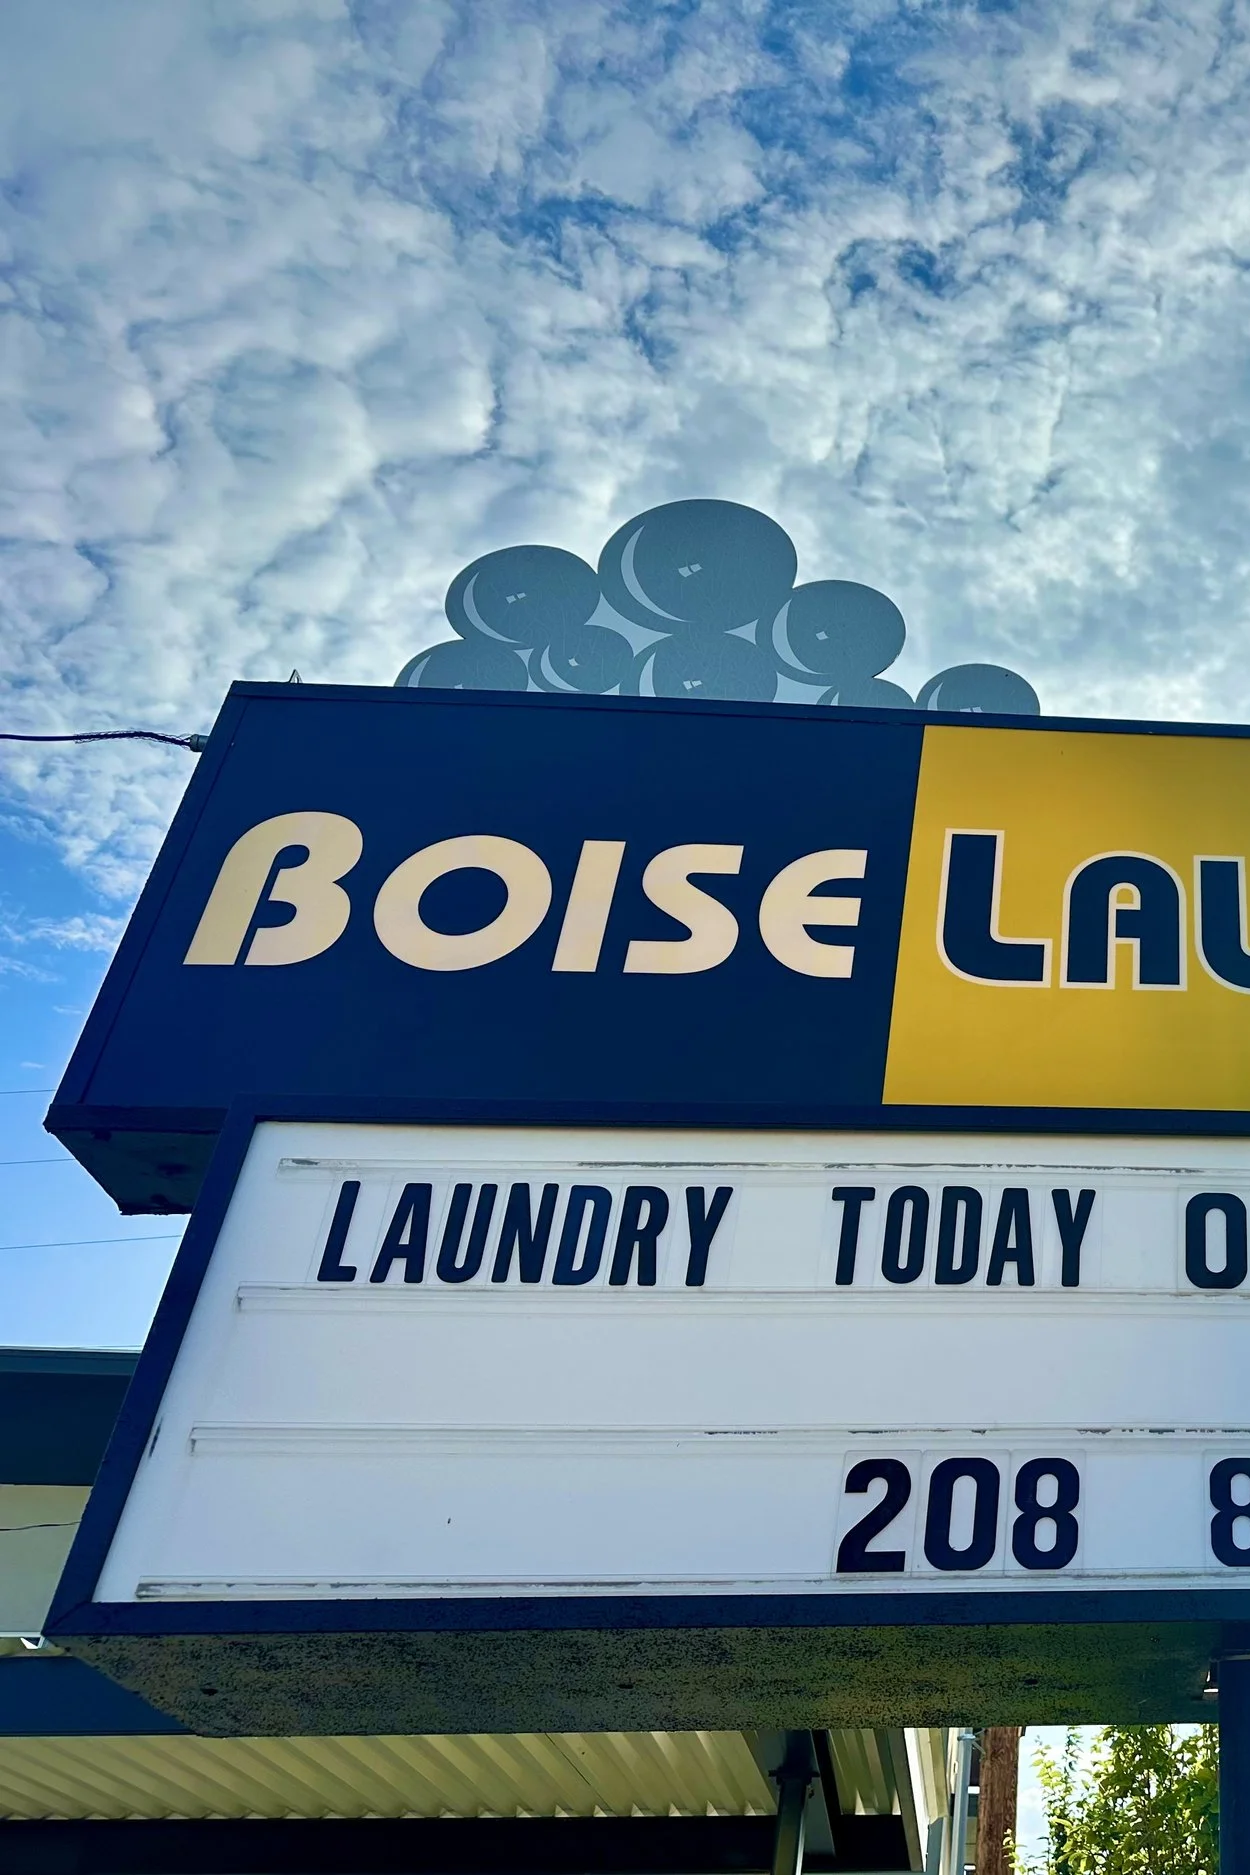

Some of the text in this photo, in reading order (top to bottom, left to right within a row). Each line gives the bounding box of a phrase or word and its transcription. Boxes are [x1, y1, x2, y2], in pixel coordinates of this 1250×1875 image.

[183, 810, 868, 979] BOISE
[317, 1180, 735, 1286] LAUNDRY
[832, 1186, 1096, 1288] TODAY
[836, 1458, 1081, 1573] 208
